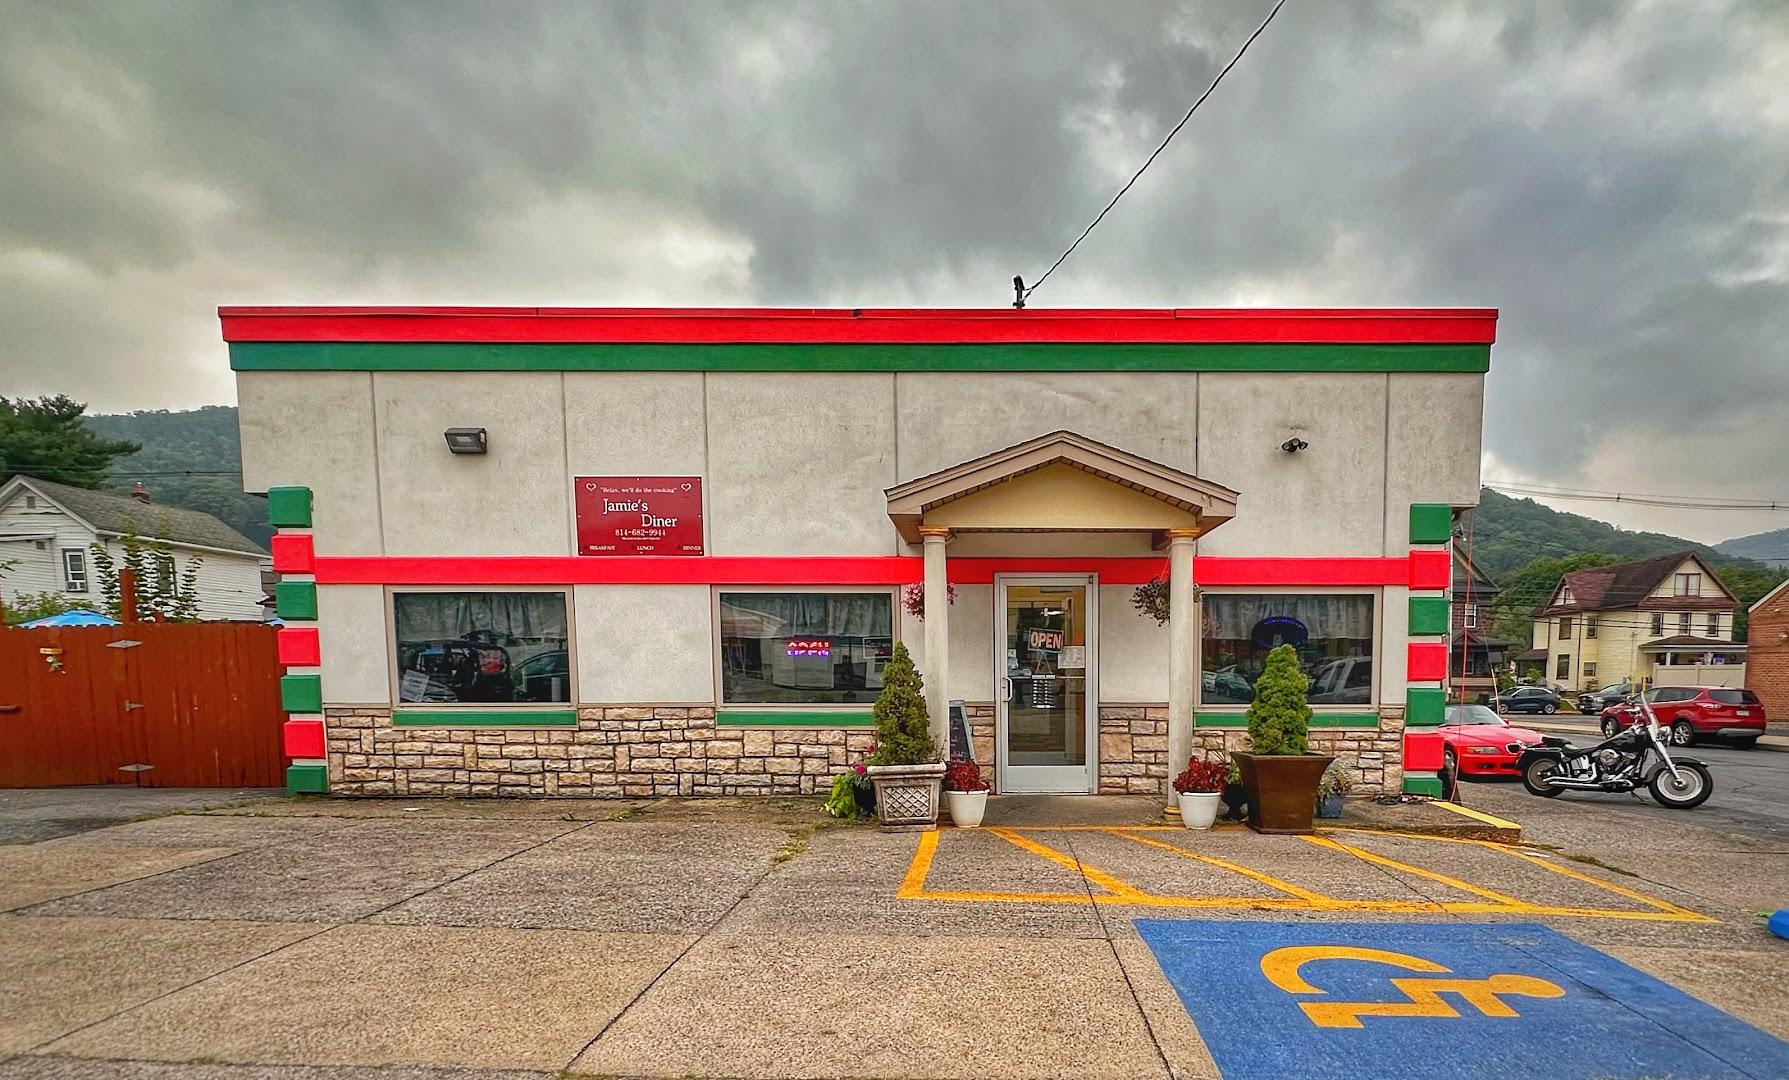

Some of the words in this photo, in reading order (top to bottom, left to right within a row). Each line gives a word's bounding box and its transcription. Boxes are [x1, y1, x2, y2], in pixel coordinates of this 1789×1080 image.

[603, 498, 648, 514] Jamie's
[641, 514, 678, 527] Diner
[1031, 632, 1061, 648] OPEN
